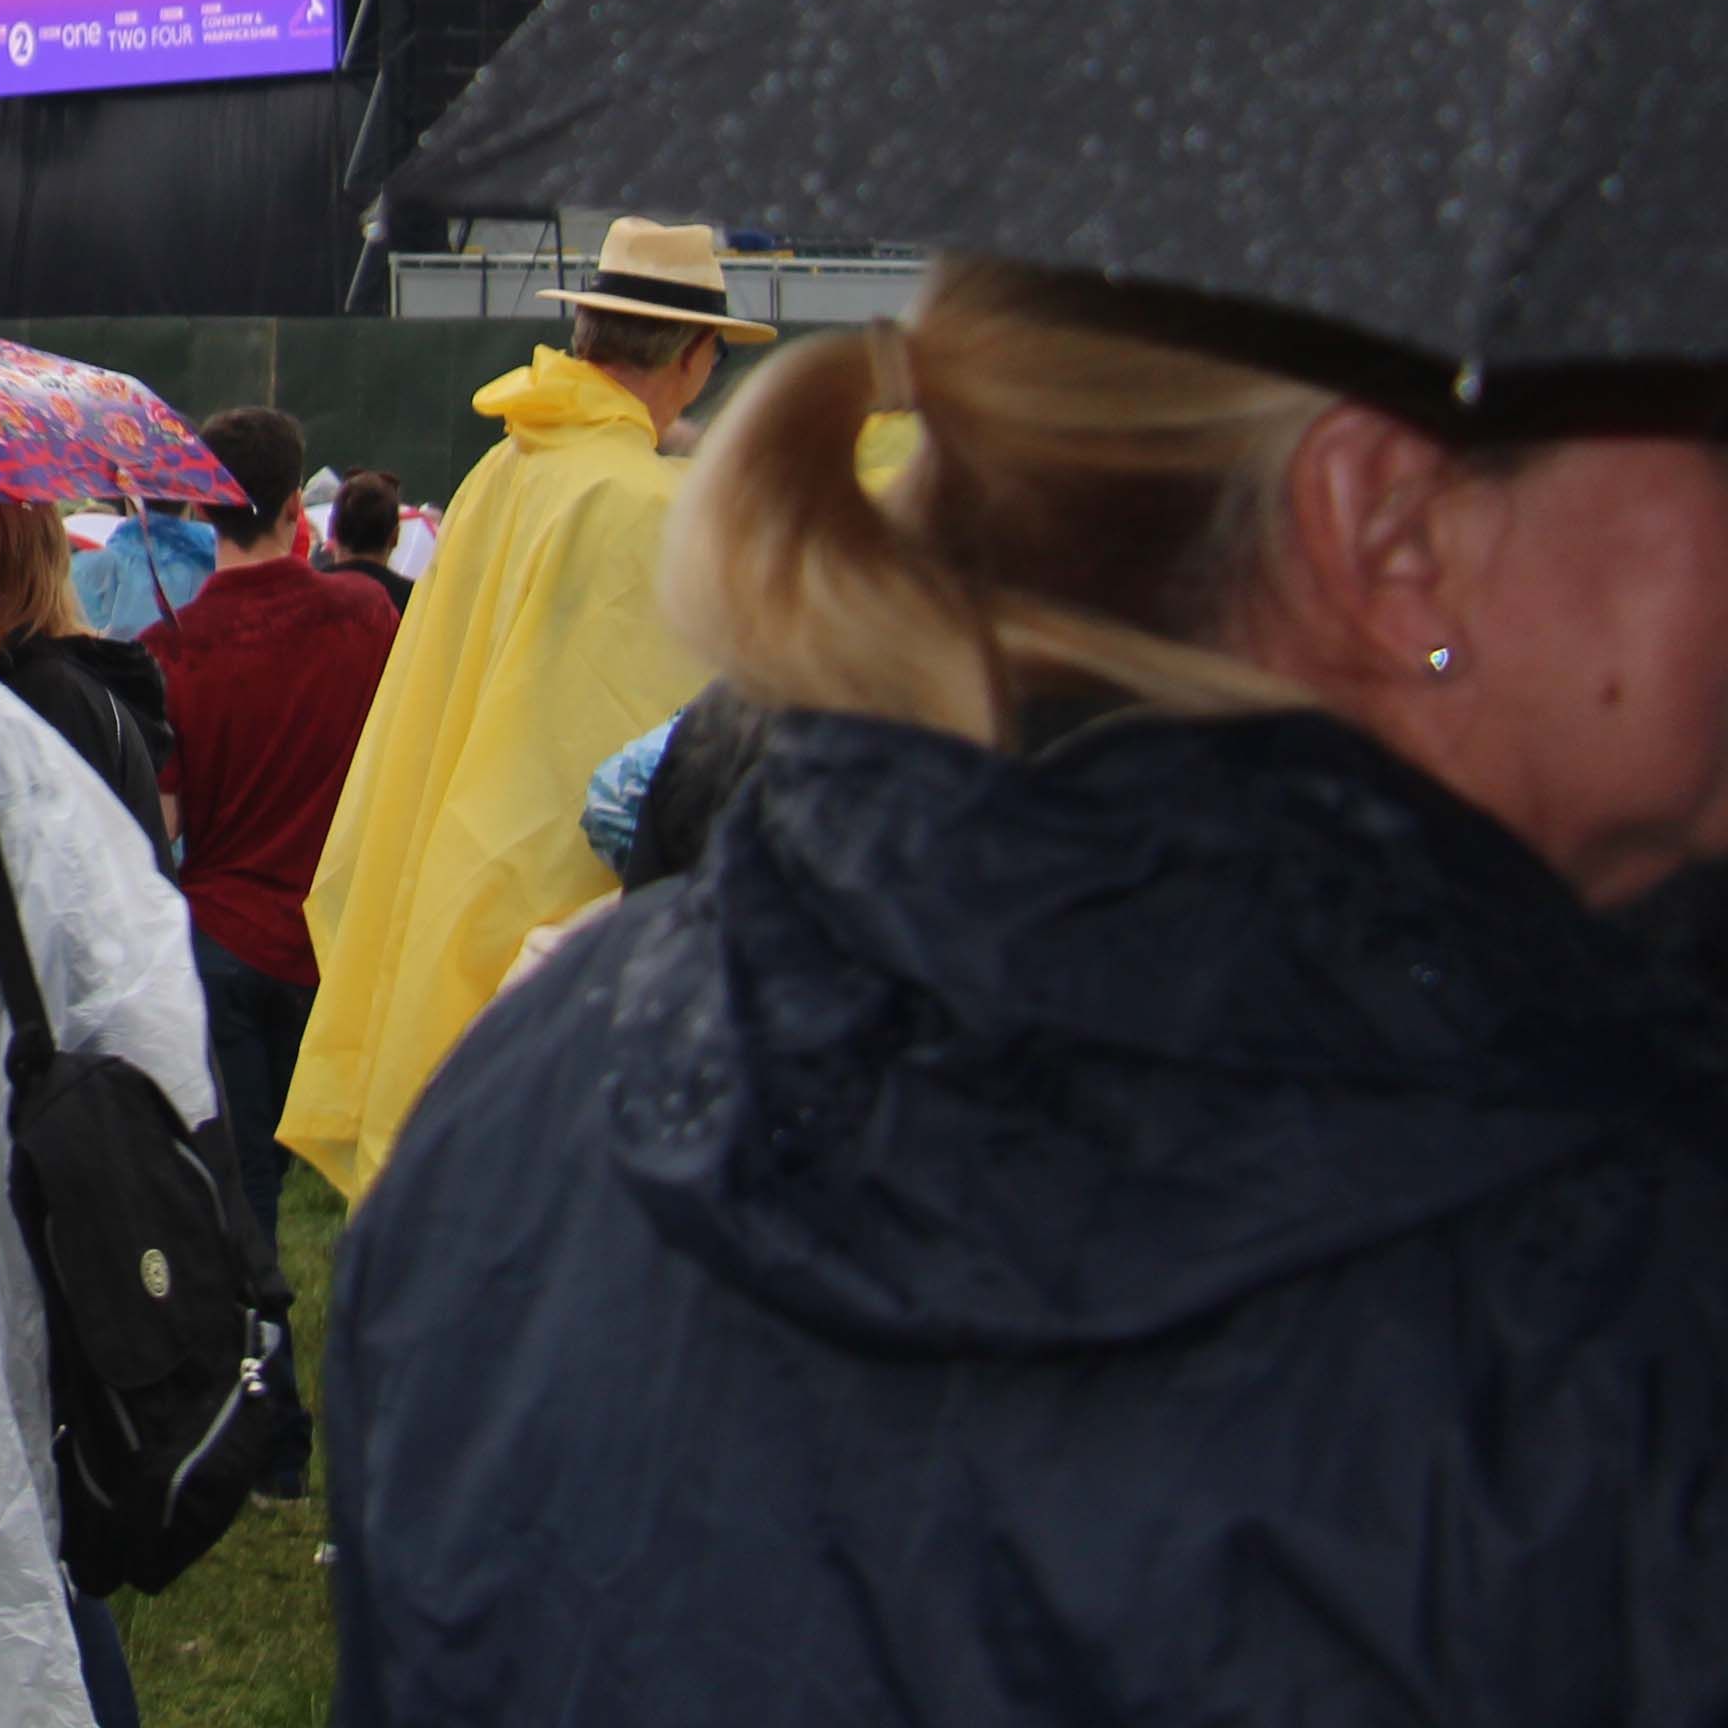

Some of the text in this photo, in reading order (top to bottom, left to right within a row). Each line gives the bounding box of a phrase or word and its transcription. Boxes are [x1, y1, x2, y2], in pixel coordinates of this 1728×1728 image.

[61, 21, 102, 49] one
[106, 26, 146, 53] TWO
[151, 23, 194, 48] FOUR
